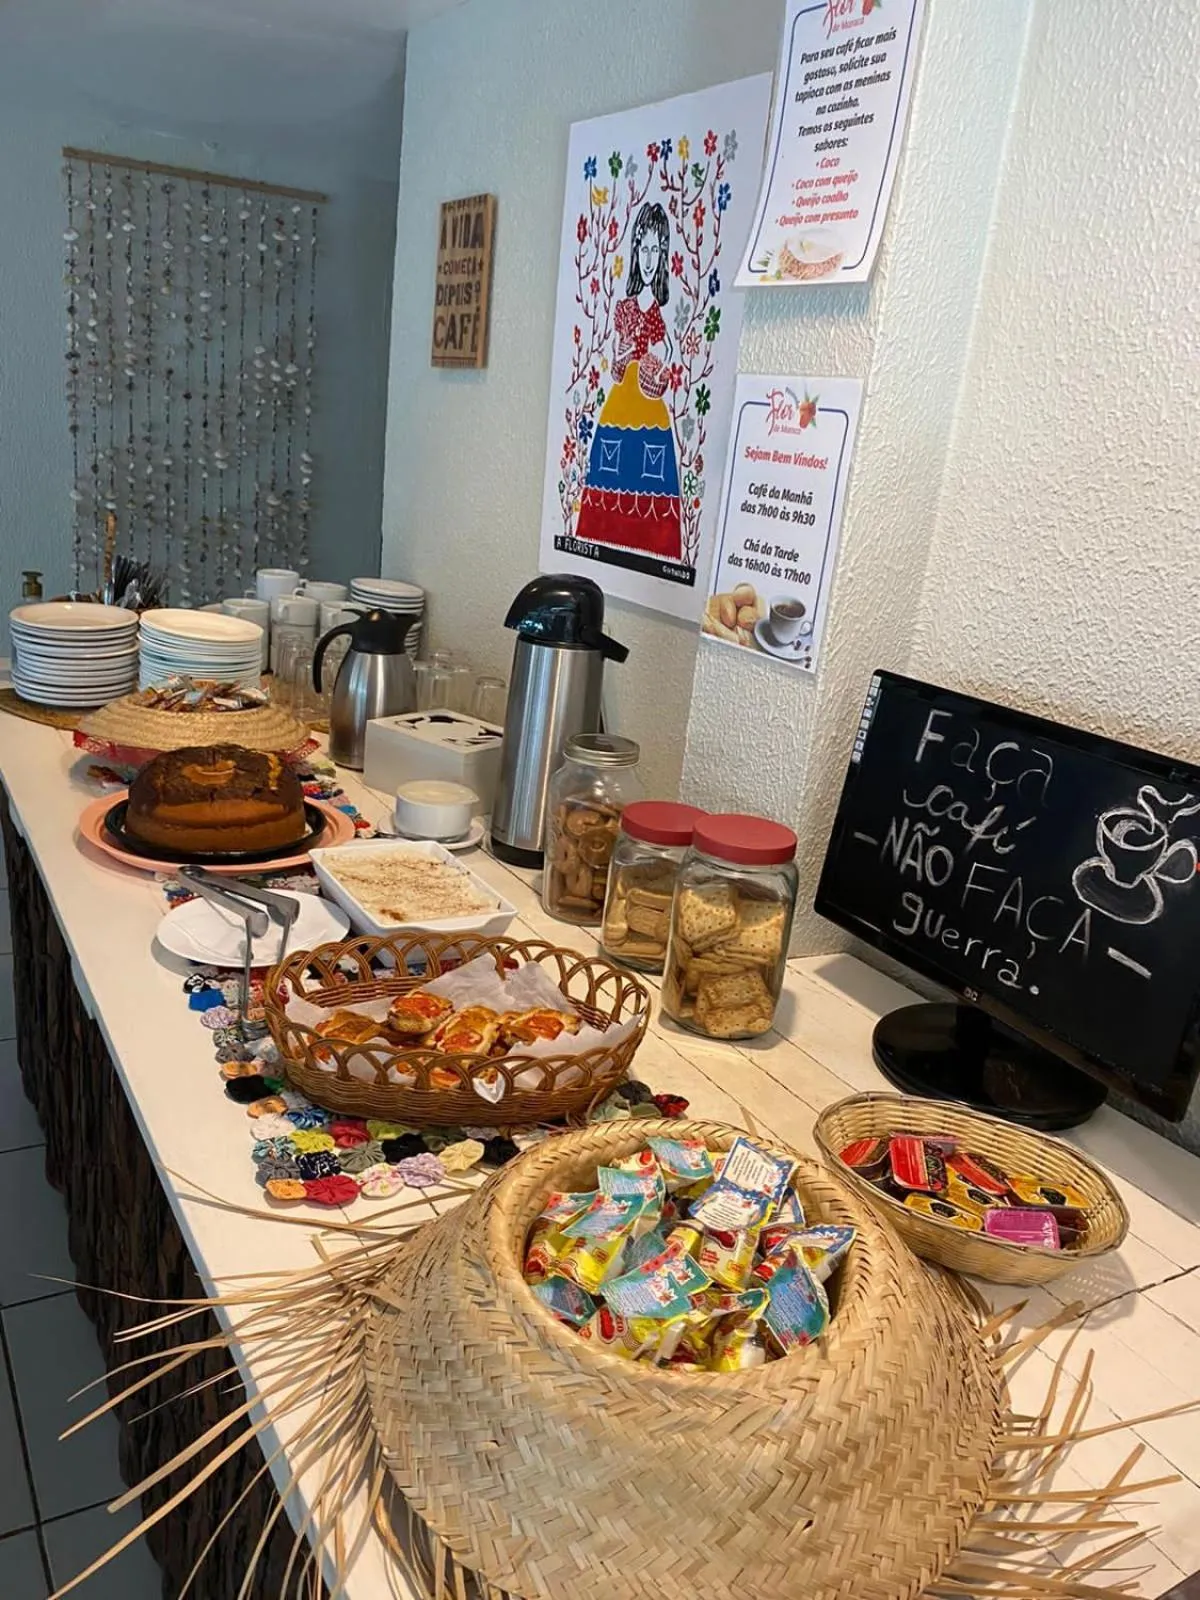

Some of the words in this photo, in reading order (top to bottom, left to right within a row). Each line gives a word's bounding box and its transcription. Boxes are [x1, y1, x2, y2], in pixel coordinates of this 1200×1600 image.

[800, 51, 819, 65] Para
[820, 47, 835, 60] seu
[835, 38, 853, 57] café
[854, 36, 875, 53] ficar
[875, 26, 897, 45] mais
[805, 67, 837, 84] gostoso,
[839, 57, 869, 73] solicite
[870, 51, 887, 65] sua
[795, 86, 824, 103] tapioca
[825, 83, 842, 96] com
[842, 79, 853, 91] as
[854, 71, 891, 87] meninas
[815, 104, 826, 116] na
[827, 96, 859, 113] cozinha.
[798, 124, 822, 137] Temos
[822, 121, 833, 133] os
[833, 113, 874, 131] seguintes
[814, 138, 848, 152] sabores:
[820, 158, 840, 169] Coco
[795, 178, 815, 191] Coco
[814, 175, 831, 188] com
[832, 170, 858, 188] queijo
[795, 193, 821, 208] Queijo
[778, 213, 803, 227] Queijo
[804, 212, 821, 225] com
[821, 209, 859, 223] presunto
[744, 446, 771, 462] Sejam
[772, 450, 792, 464] Bem
[792, 451, 828, 470] Vindos!
[748, 482, 768, 497] Café
[768, 485, 780, 500] da
[781, 488, 814, 506] Manhã
[740, 500, 757, 514] das
[758, 503, 778, 519] 7h00
[779, 506, 791, 522] às
[791, 509, 816, 527] 9h30
[556, 537, 562, 548] A
[564, 539, 599, 558] FLORISTA
[743, 538, 759, 552] Chá
[760, 541, 773, 556] da
[774, 543, 800, 563] Tarde
[728, 553, 743, 568] das
[744, 557, 771, 575] 16h00
[771, 563, 782, 578] às
[784, 568, 811, 585] 17h00
